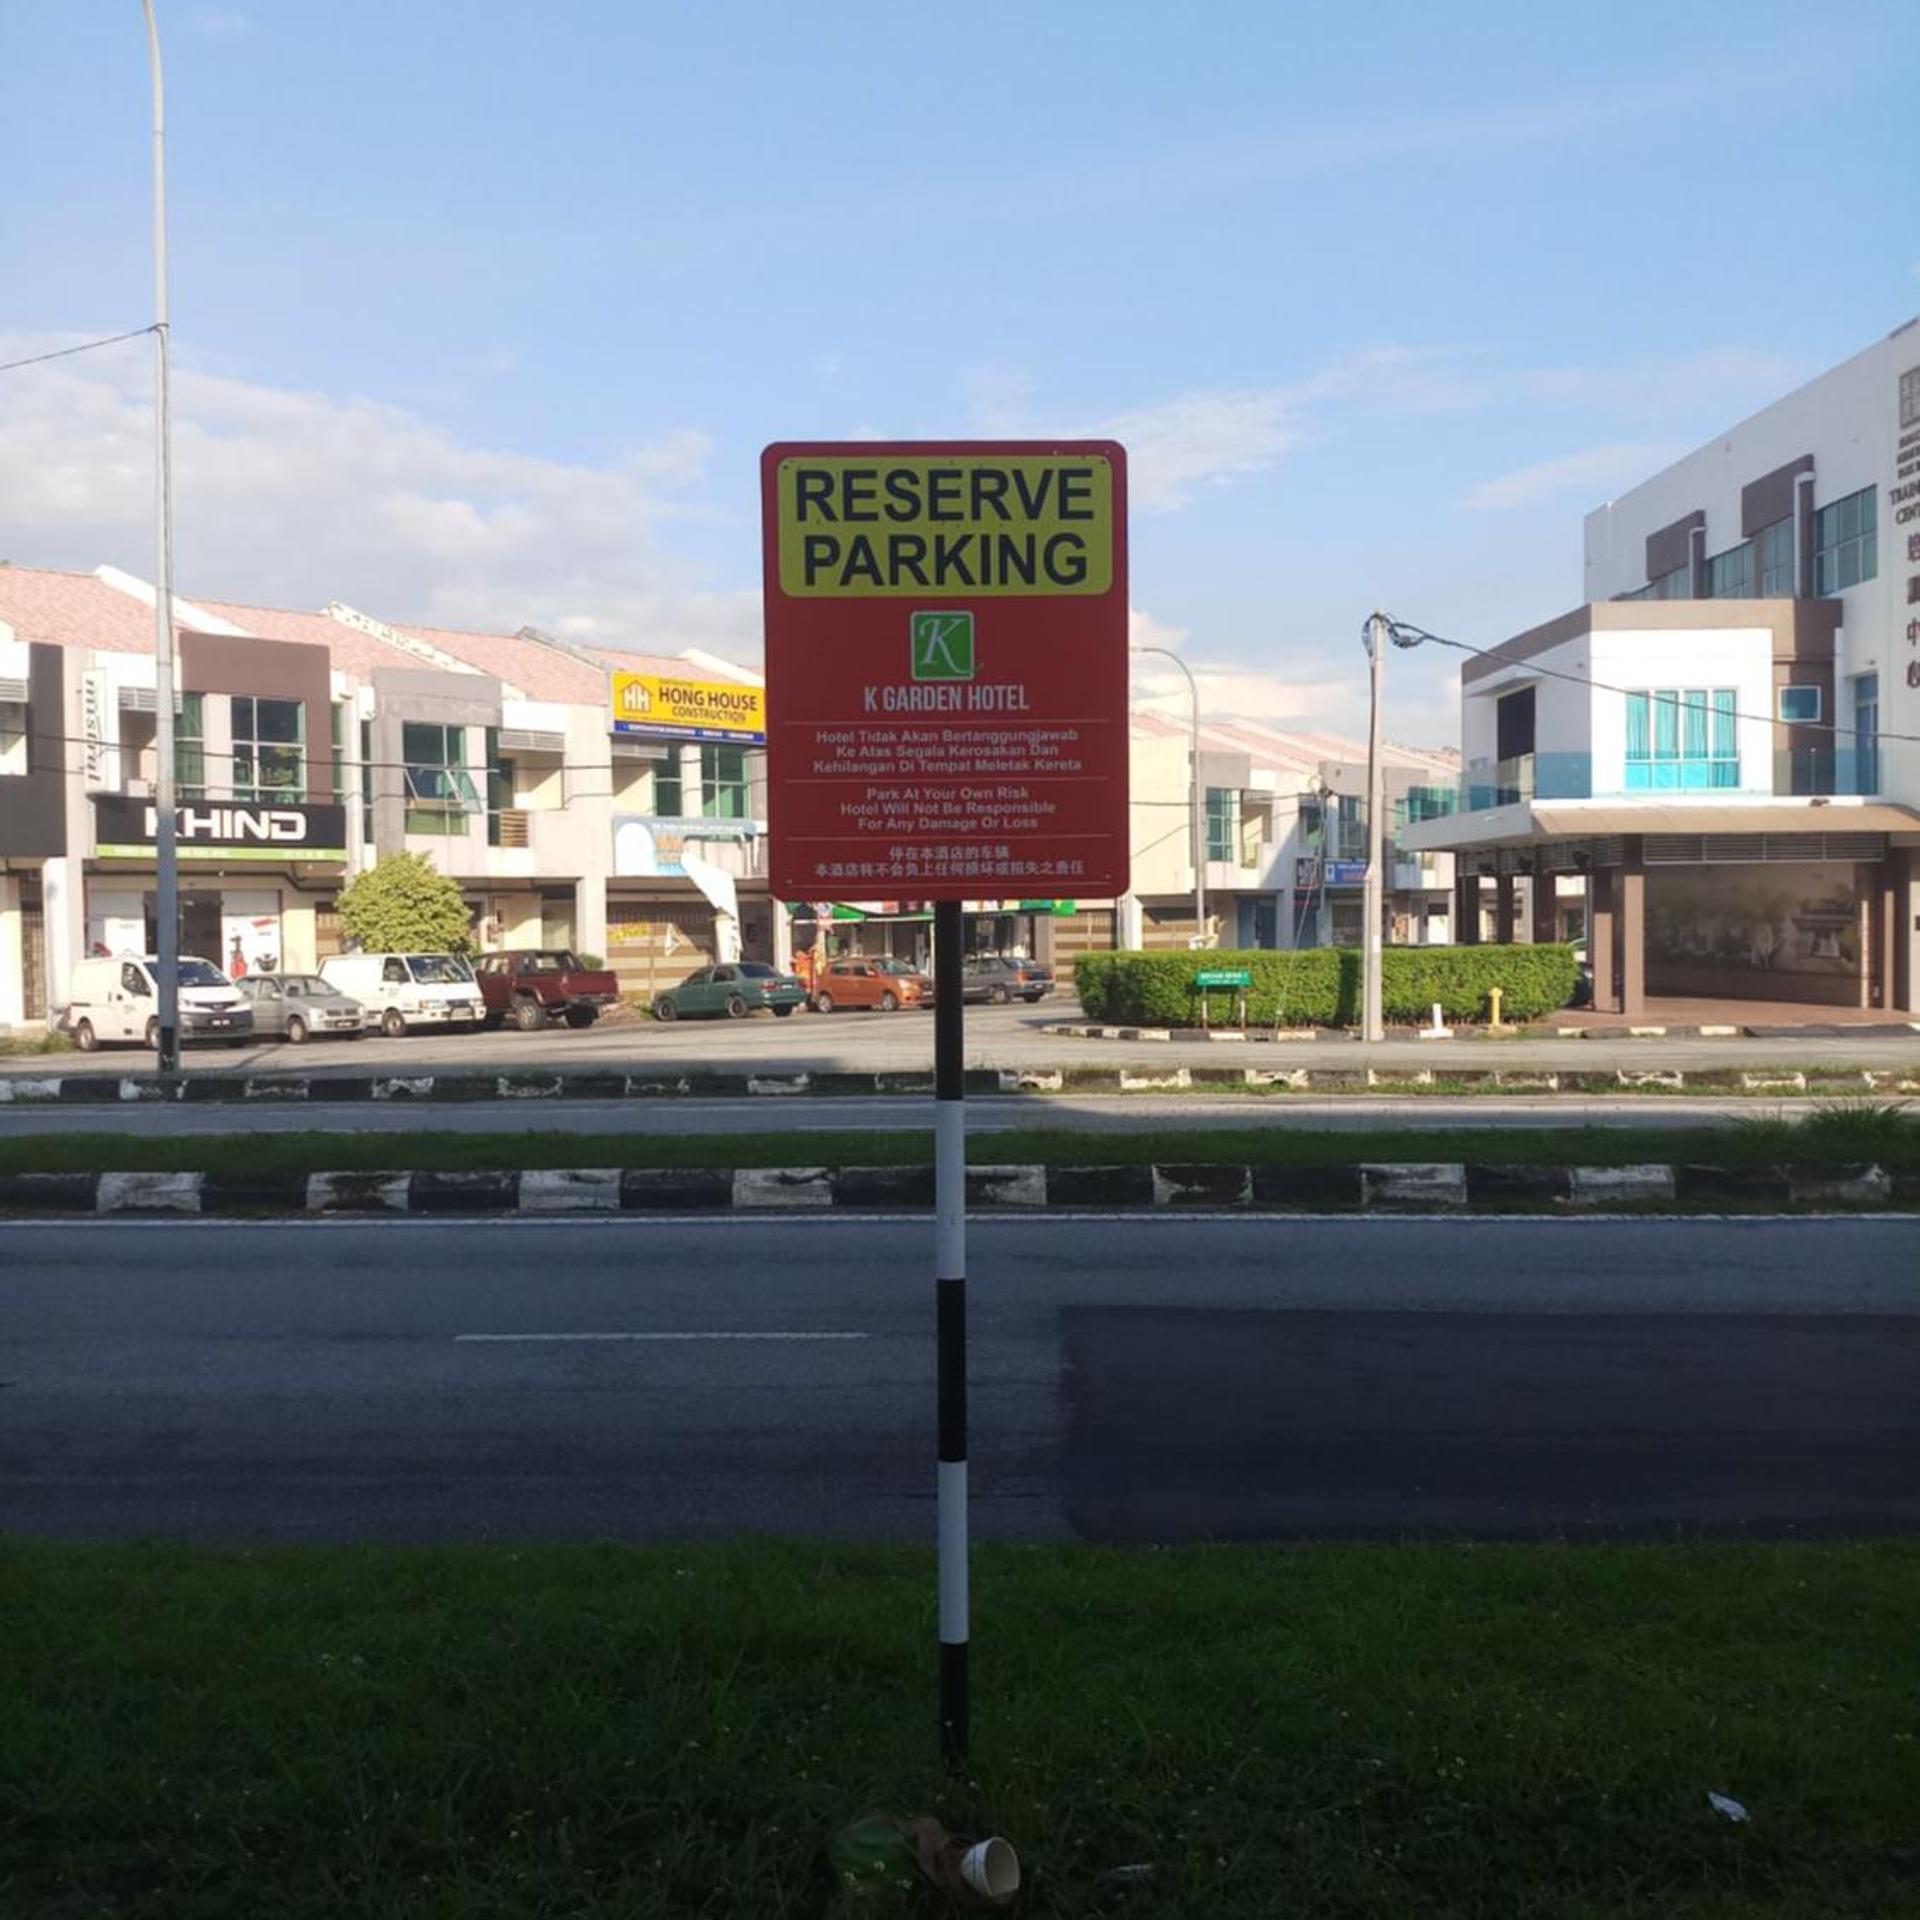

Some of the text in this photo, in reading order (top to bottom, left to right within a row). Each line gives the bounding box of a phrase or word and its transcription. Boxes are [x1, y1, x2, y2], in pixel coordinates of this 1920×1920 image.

[796, 468, 1093, 522] RESERVE
[804, 533, 1087, 586] PARKING
[920, 618, 972, 674] K
[659, 686, 758, 711] HONG HOUSE
[864, 685, 1029, 711] K GARDEN HOTEL
[672, 706, 746, 723] CONSTRUCTION
[816, 730, 1078, 744] Hotel Tidak Akan Bertanggungjawab
[837, 744, 1058, 759] Ke Atas Segala Kerosakan Dan
[814, 760, 1081, 774] Kehilangan Di Tempat Meletak Kereta
[867, 787, 1028, 800] Park At Your Own Risk
[841, 802, 1055, 815] Hotel Will Not Be Responsible
[145, 807, 307, 840] KHIND
[858, 816, 1038, 832] For Any Damage Or Loss
